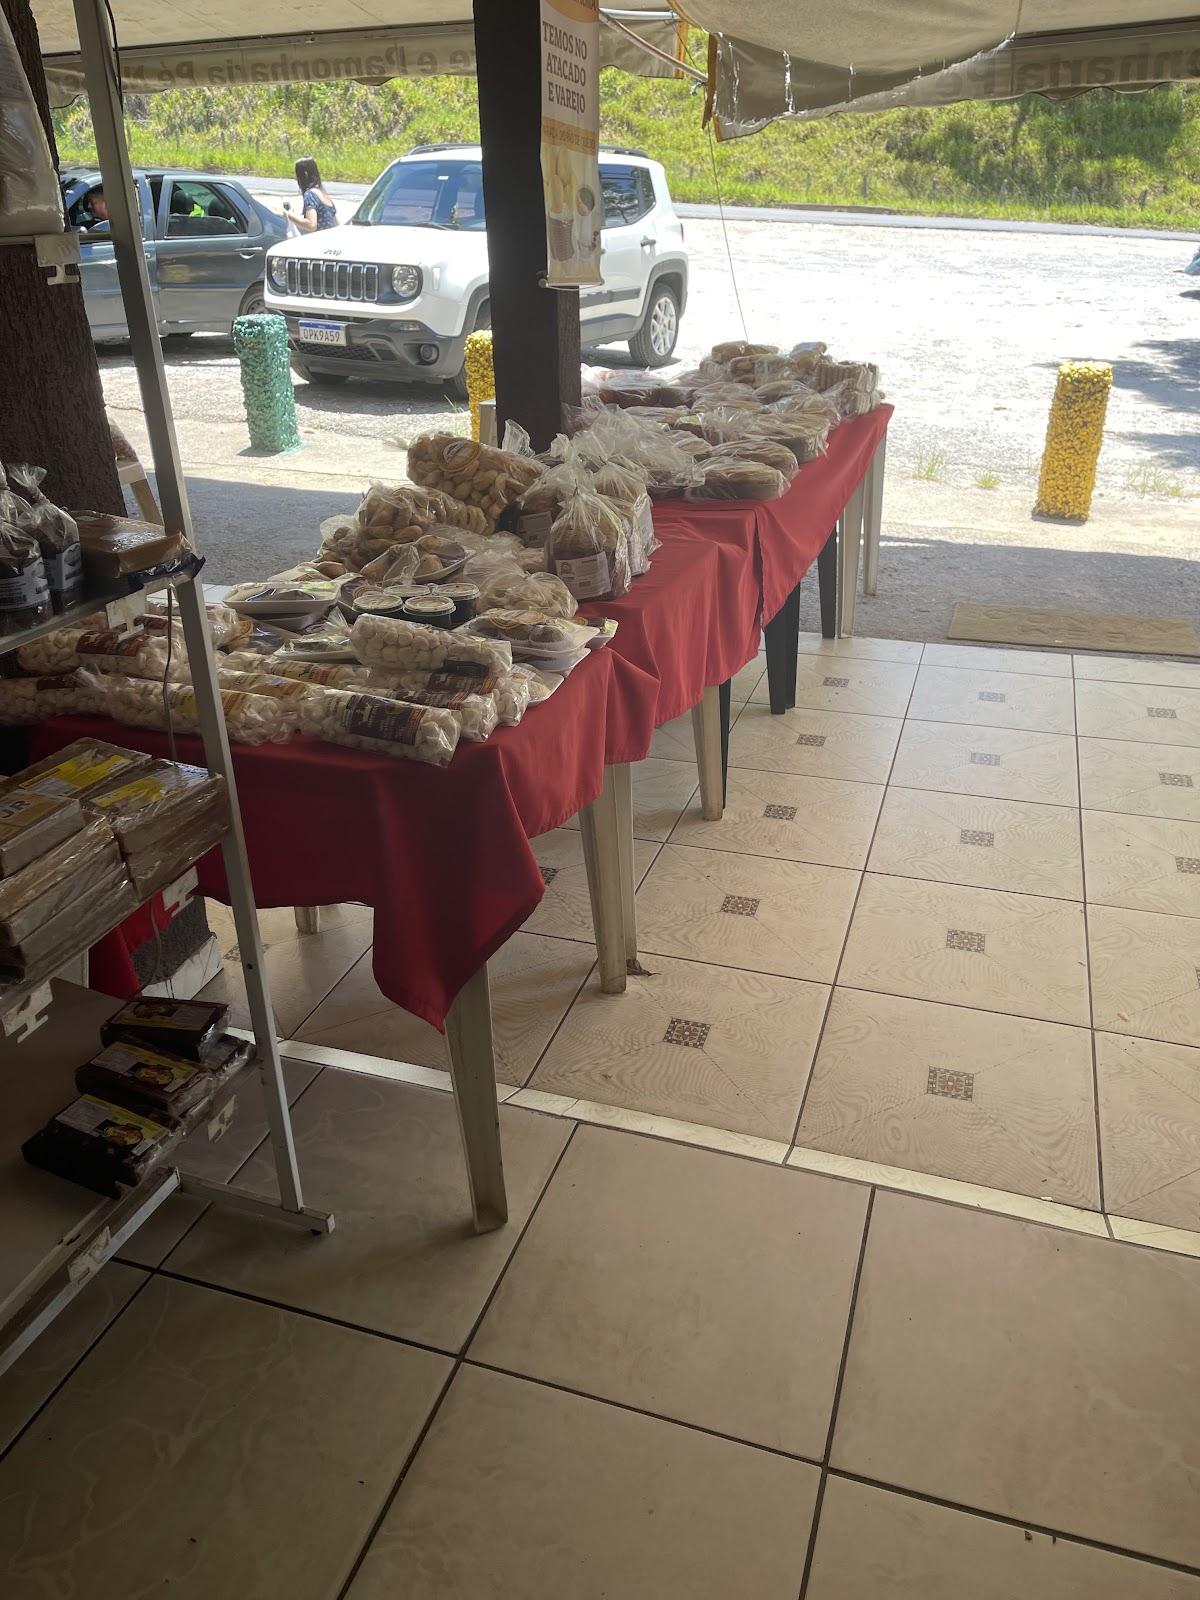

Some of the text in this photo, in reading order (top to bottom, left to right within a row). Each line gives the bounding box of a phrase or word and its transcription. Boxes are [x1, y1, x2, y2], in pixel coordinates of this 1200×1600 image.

[542, 20, 574, 54] TEMOS
[574, 36, 588, 61] NO
[546, 52, 586, 88] ATACADO
[547, 80, 586, 115] E VAREJO
